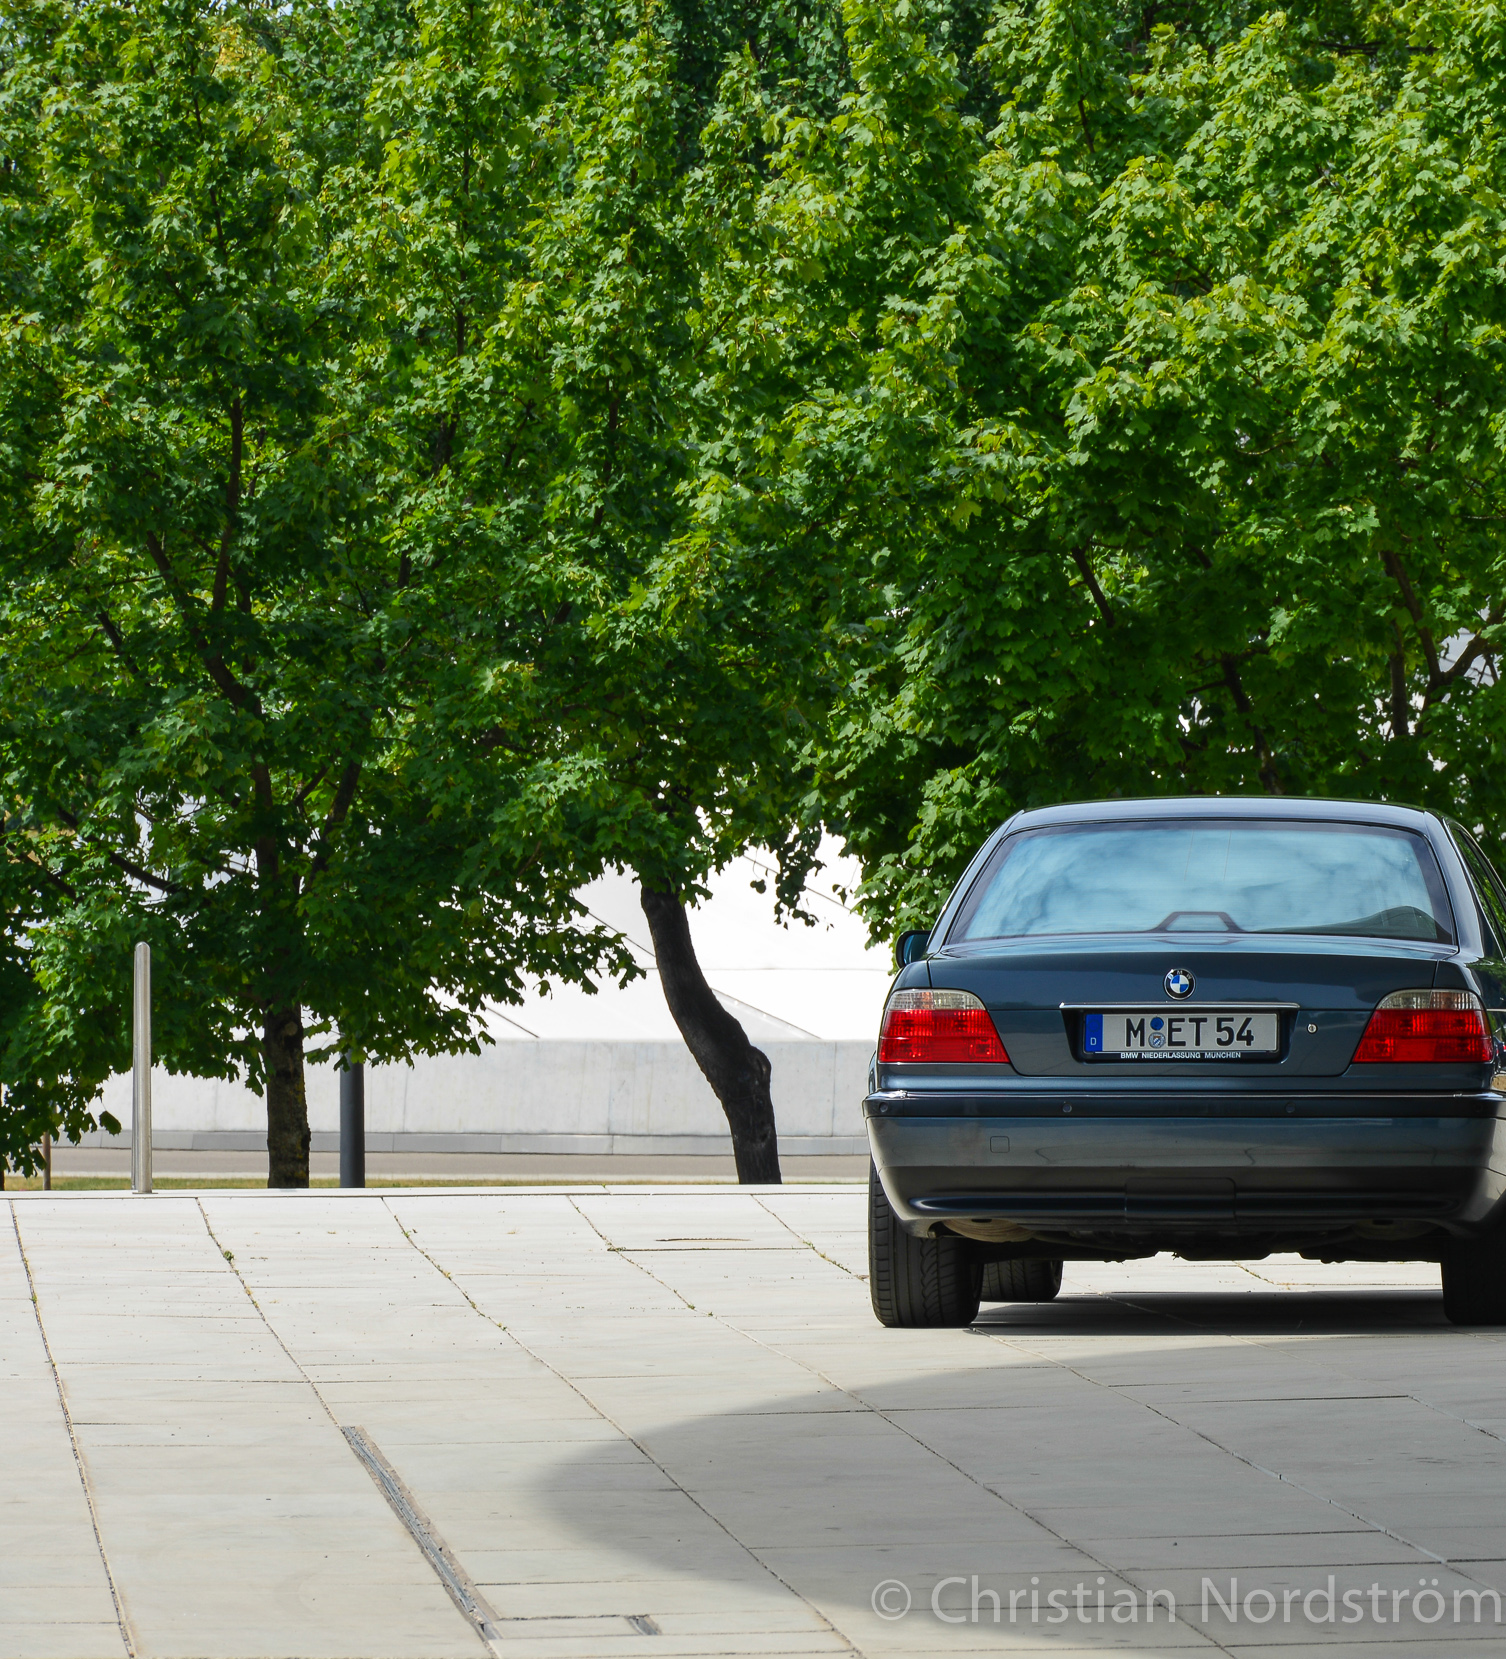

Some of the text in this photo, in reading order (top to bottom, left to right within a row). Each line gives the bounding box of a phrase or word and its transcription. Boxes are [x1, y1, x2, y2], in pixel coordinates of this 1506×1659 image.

[1126, 1017, 1255, 1047] M ET 54
[1090, 1037, 1097, 1046] D
[1120, 1052, 1139, 1060] BMW
[1141, 1052, 1201, 1060] NIEDERLASSUNG
